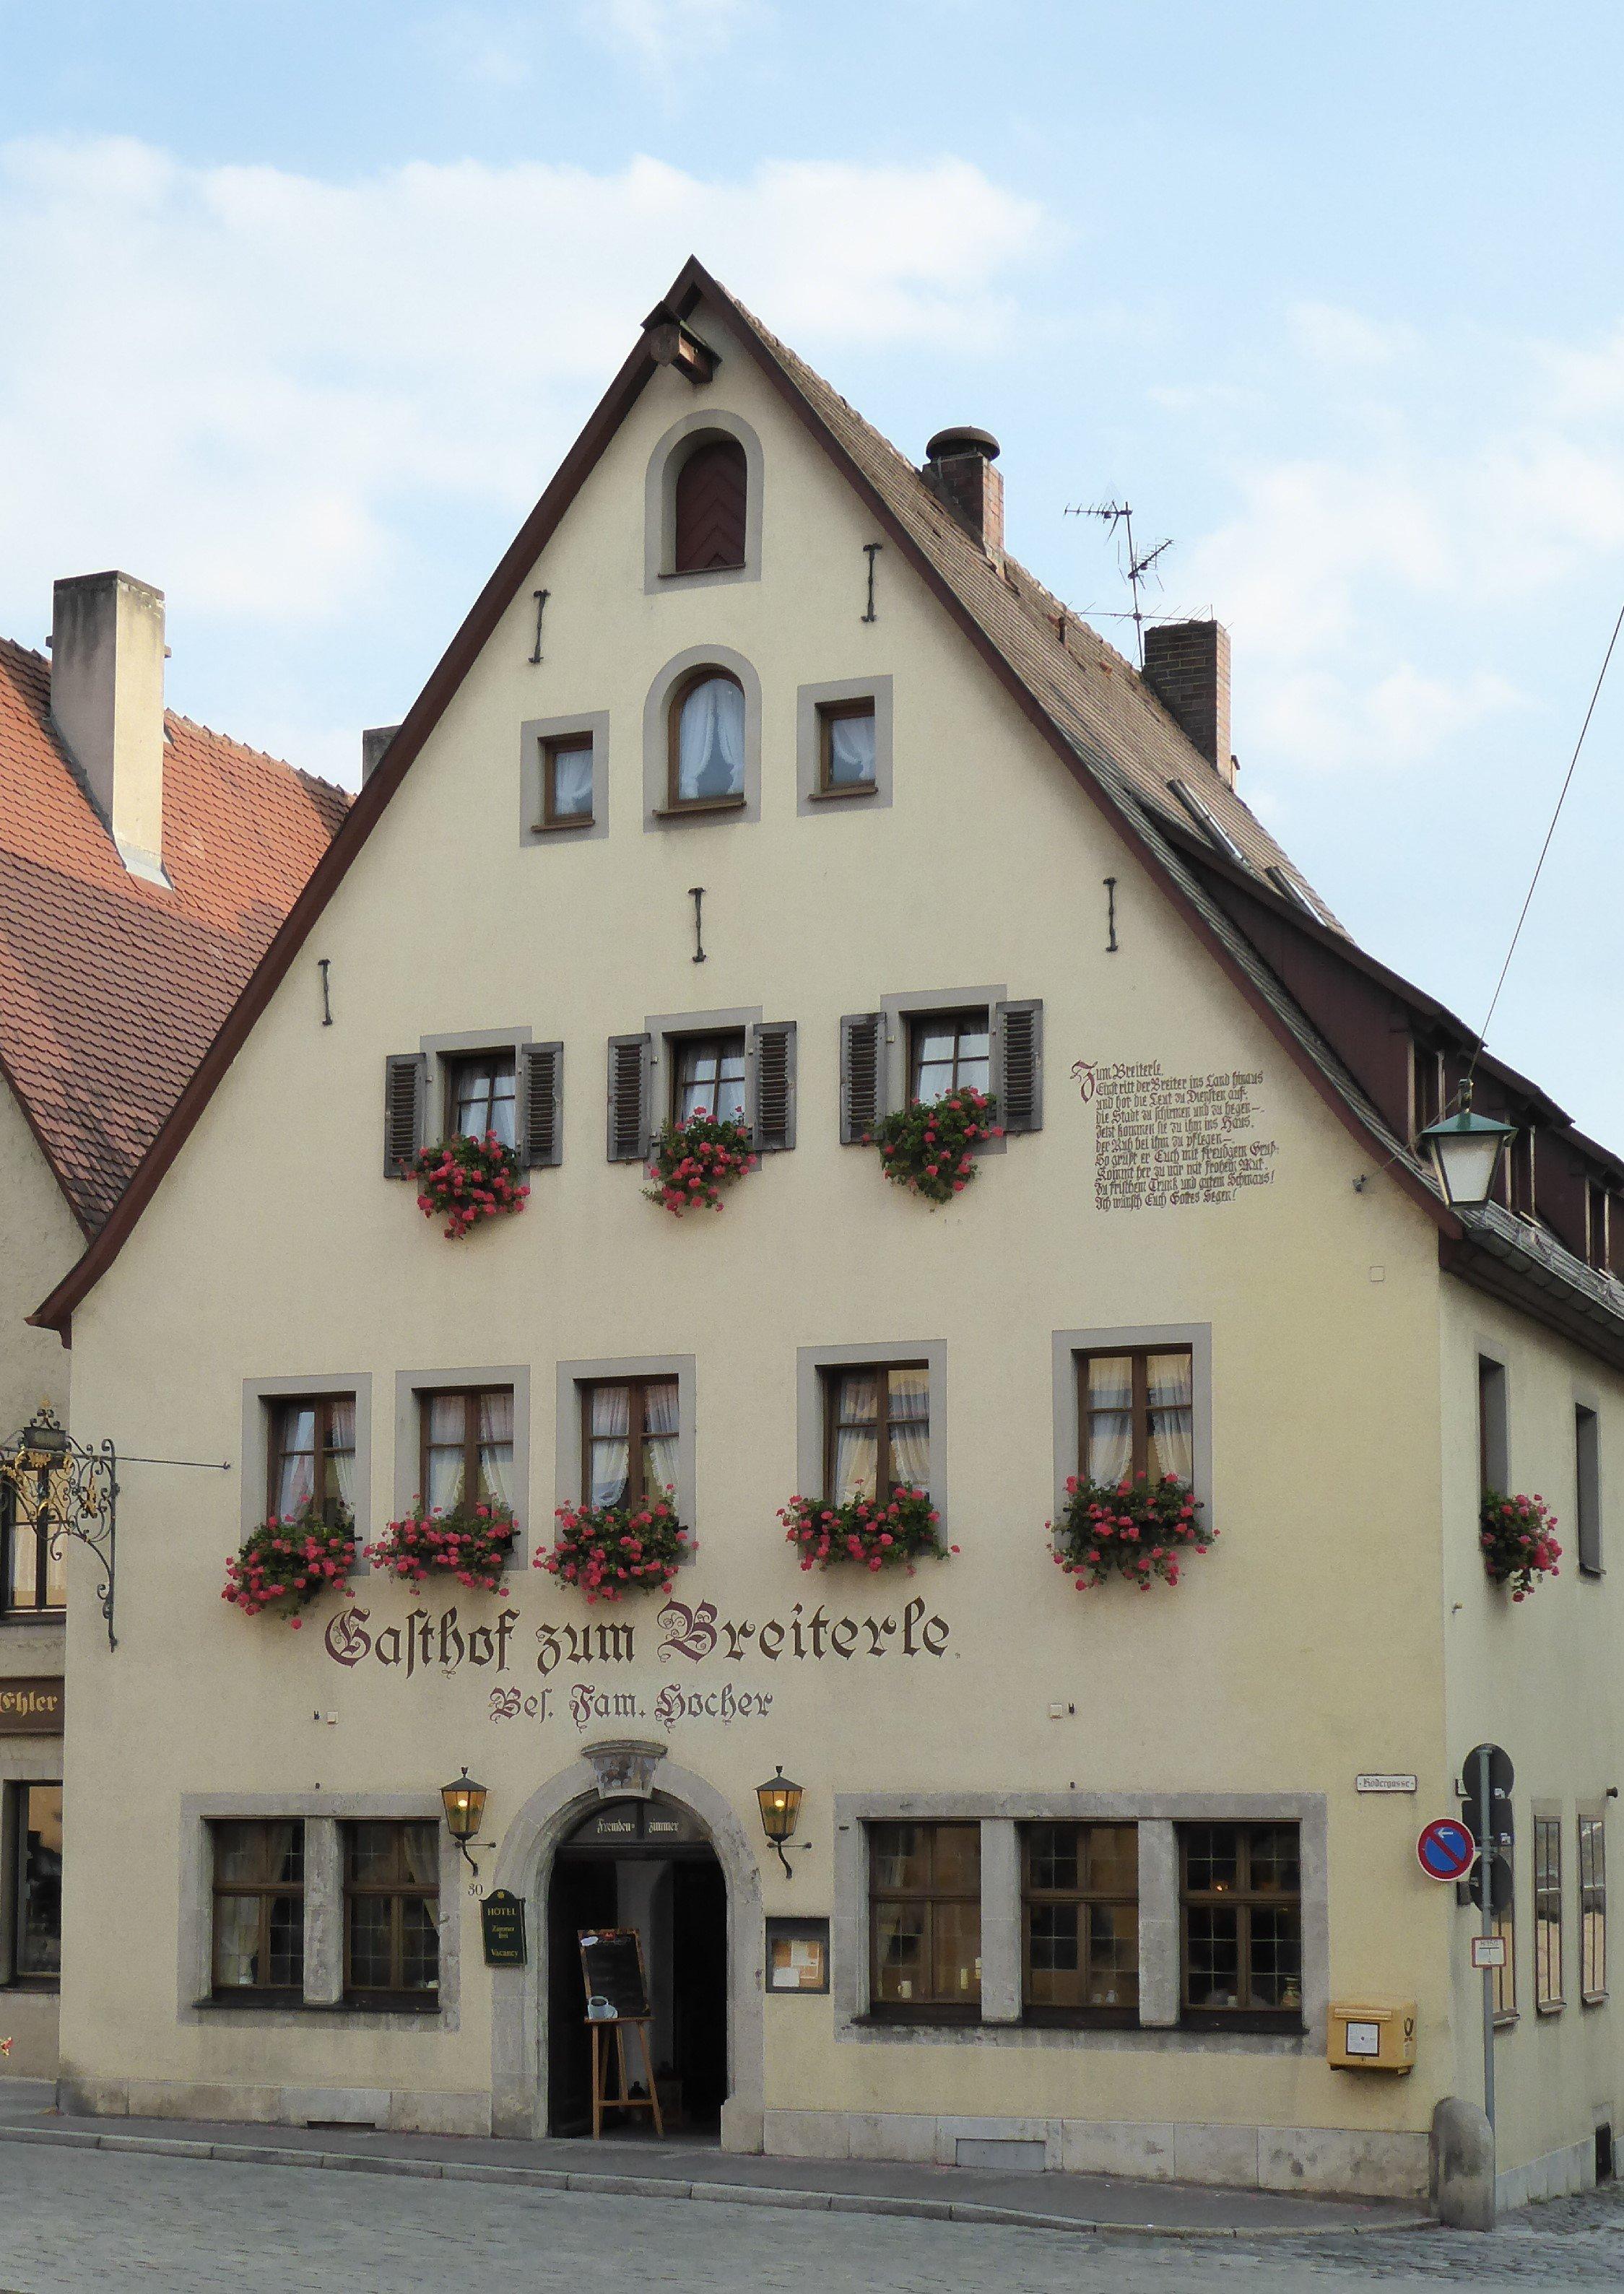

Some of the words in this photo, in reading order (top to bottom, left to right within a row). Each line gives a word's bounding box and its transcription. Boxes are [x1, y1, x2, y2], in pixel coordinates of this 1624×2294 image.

[1137, 1079, 1150, 1092] der
[1189, 1075, 1204, 1089] ins
[1205, 1073, 1230, 1087] Land
[1096, 1097, 1113, 1111] und
[1175, 1092, 1184, 1103] zu
[1096, 1110, 1109, 1124] die
[1112, 1108, 1139, 1124] Stadt
[1142, 1110, 1152, 1121] zu
[1193, 1103, 1210, 1117] und
[1212, 1104, 1223, 1116] zu
[1117, 1123, 1155, 1137] kommen
[1170, 1122, 1182, 1134] zu
[1204, 1117, 1217, 1131] ins
[1096, 1140, 1111, 1153] der
[1172, 1136, 1183, 1147] zu
[1095, 1152, 1110, 1166] So
[1098, 1166, 1134, 1181] Kommt
[1154, 1165, 1165, 1178] zu
[1186, 1161, 1202, 1176] mit
[1181, 1176, 1197, 1190] und
[535, 1622, 635, 1677] zum
[656, 1595, 950, 1664] Breiterle
[570, 1683, 647, 1734] Fam.
[653, 1682, 773, 1734] Hocher
[487, 1907, 516, 1916] HOTEL
